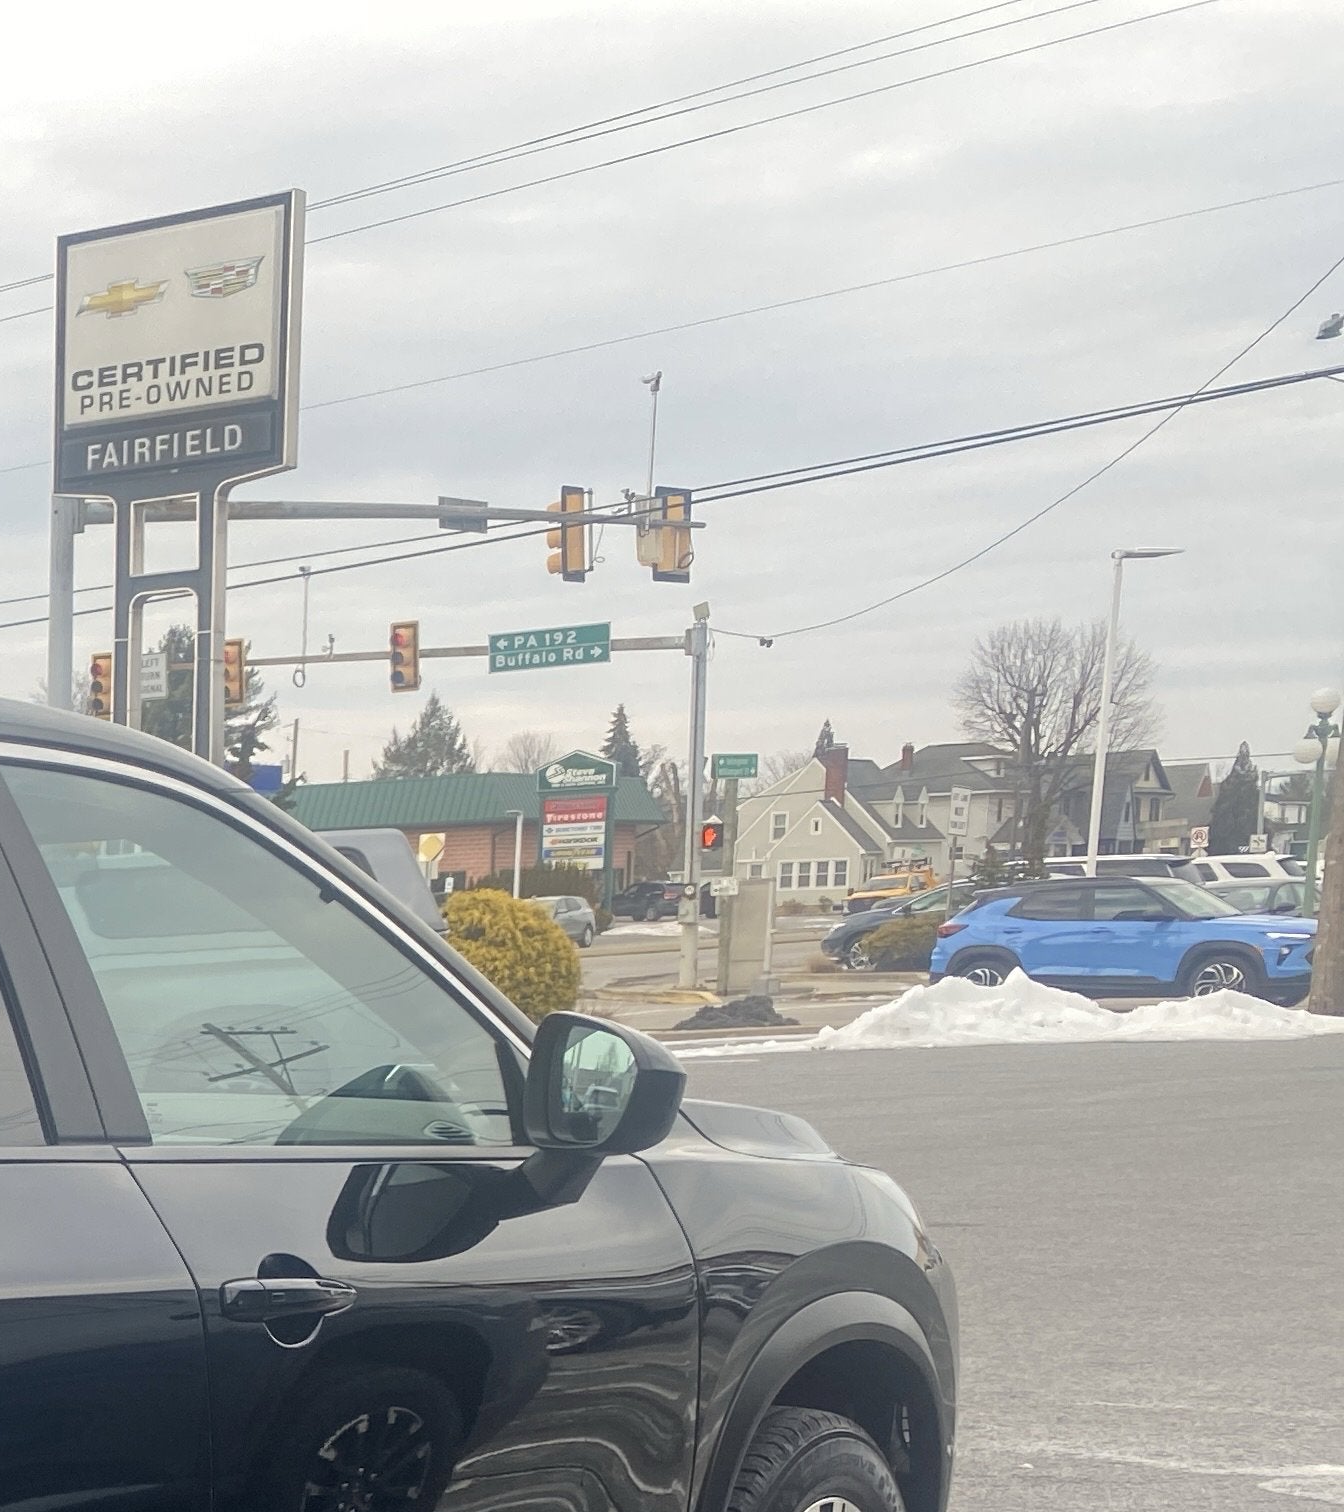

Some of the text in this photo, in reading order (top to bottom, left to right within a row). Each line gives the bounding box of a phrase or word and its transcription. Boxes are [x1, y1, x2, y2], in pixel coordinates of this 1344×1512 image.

[71, 342, 265, 392] CERTIFIED
[80, 370, 254, 415] PRE-OWNED
[86, 424, 243, 471] FAIRFIELD
[495, 648, 584, 667] Buffalo Rd
[514, 630, 577, 648] PA 192
